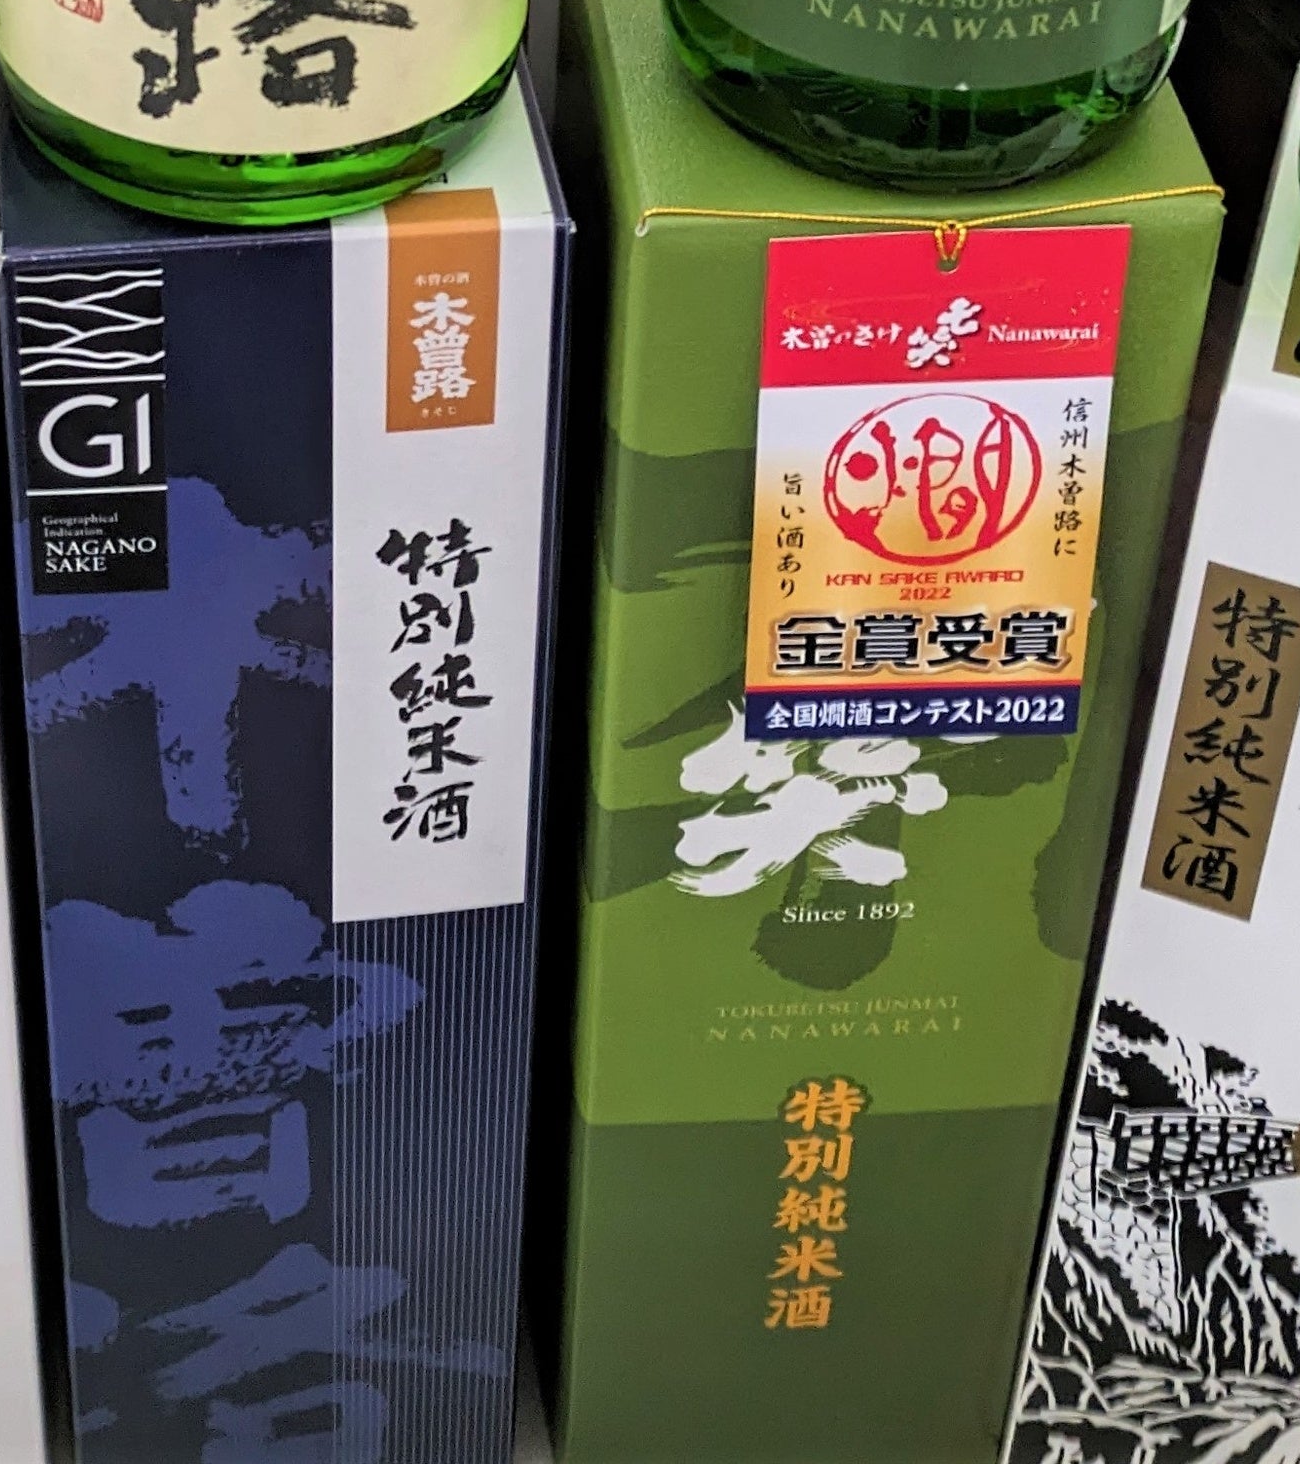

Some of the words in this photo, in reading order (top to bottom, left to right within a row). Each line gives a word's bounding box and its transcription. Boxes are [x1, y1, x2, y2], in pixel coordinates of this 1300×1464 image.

[988, 321, 1100, 343] Nanawarai
[38, 393, 152, 478] GI
[1053, 397, 1094, 557] 信州木曽路に
[41, 511, 119, 527] Geographical
[43, 526, 104, 537] Indication
[775, 472, 805, 600] 旨い酒あり
[45, 536, 157, 556] NAGANO
[45, 556, 107, 574] SAKE
[826, 570, 872, 586] KAN
[879, 570, 939, 586] SAKE
[945, 569, 1026, 585] AWARD
[899, 587, 953, 601] 2022
[773, 610, 1069, 674] 金賞受賞
[375, 518, 493, 844] 特別純米酒
[765, 696, 1066, 731] 全国燗酒コンテスト2022
[1161, 585, 1300, 906] 特別純米酒
[782, 906, 847, 924] Since
[857, 902, 916, 920] 1892
[716, 1001, 852, 1019] TOKUBETSU
[865, 995, 959, 1015] JUNMAI
[708, 1017, 963, 1040] NANAWARAI
[763, 1078, 868, 1330] 特別純米酒
